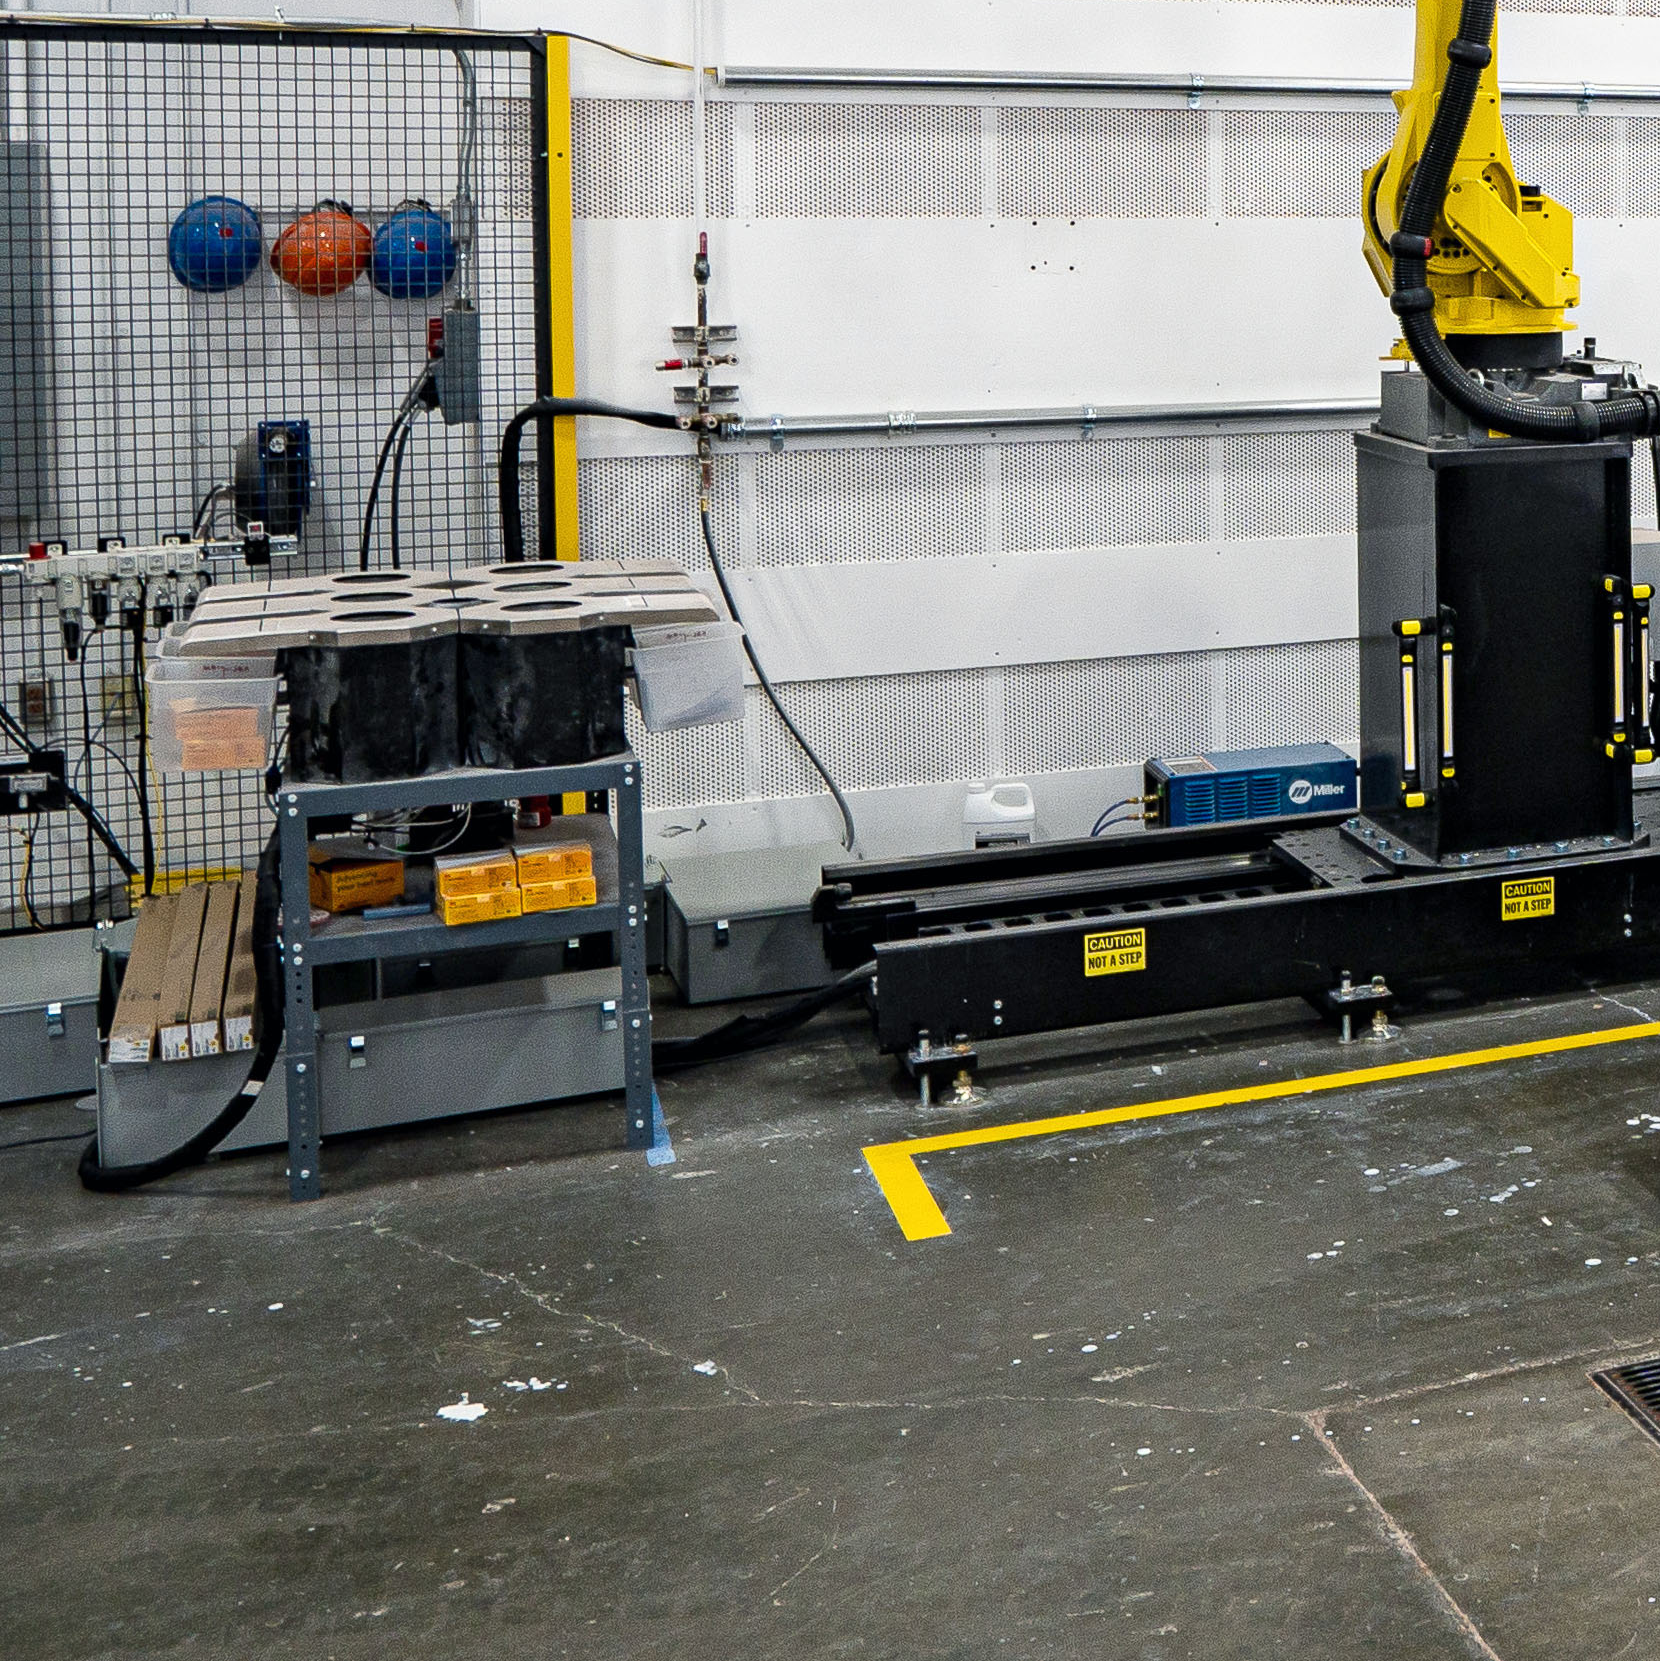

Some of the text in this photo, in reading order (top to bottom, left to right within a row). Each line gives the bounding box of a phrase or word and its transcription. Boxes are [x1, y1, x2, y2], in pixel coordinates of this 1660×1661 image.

[1314, 783, 1345, 796] Miller
[1505, 882, 1550, 897] CAUTION
[1505, 898, 1551, 914] NOT A STEP
[1089, 934, 1141, 951] CAUTION
[1088, 951, 1142, 970] NOT A STEP
